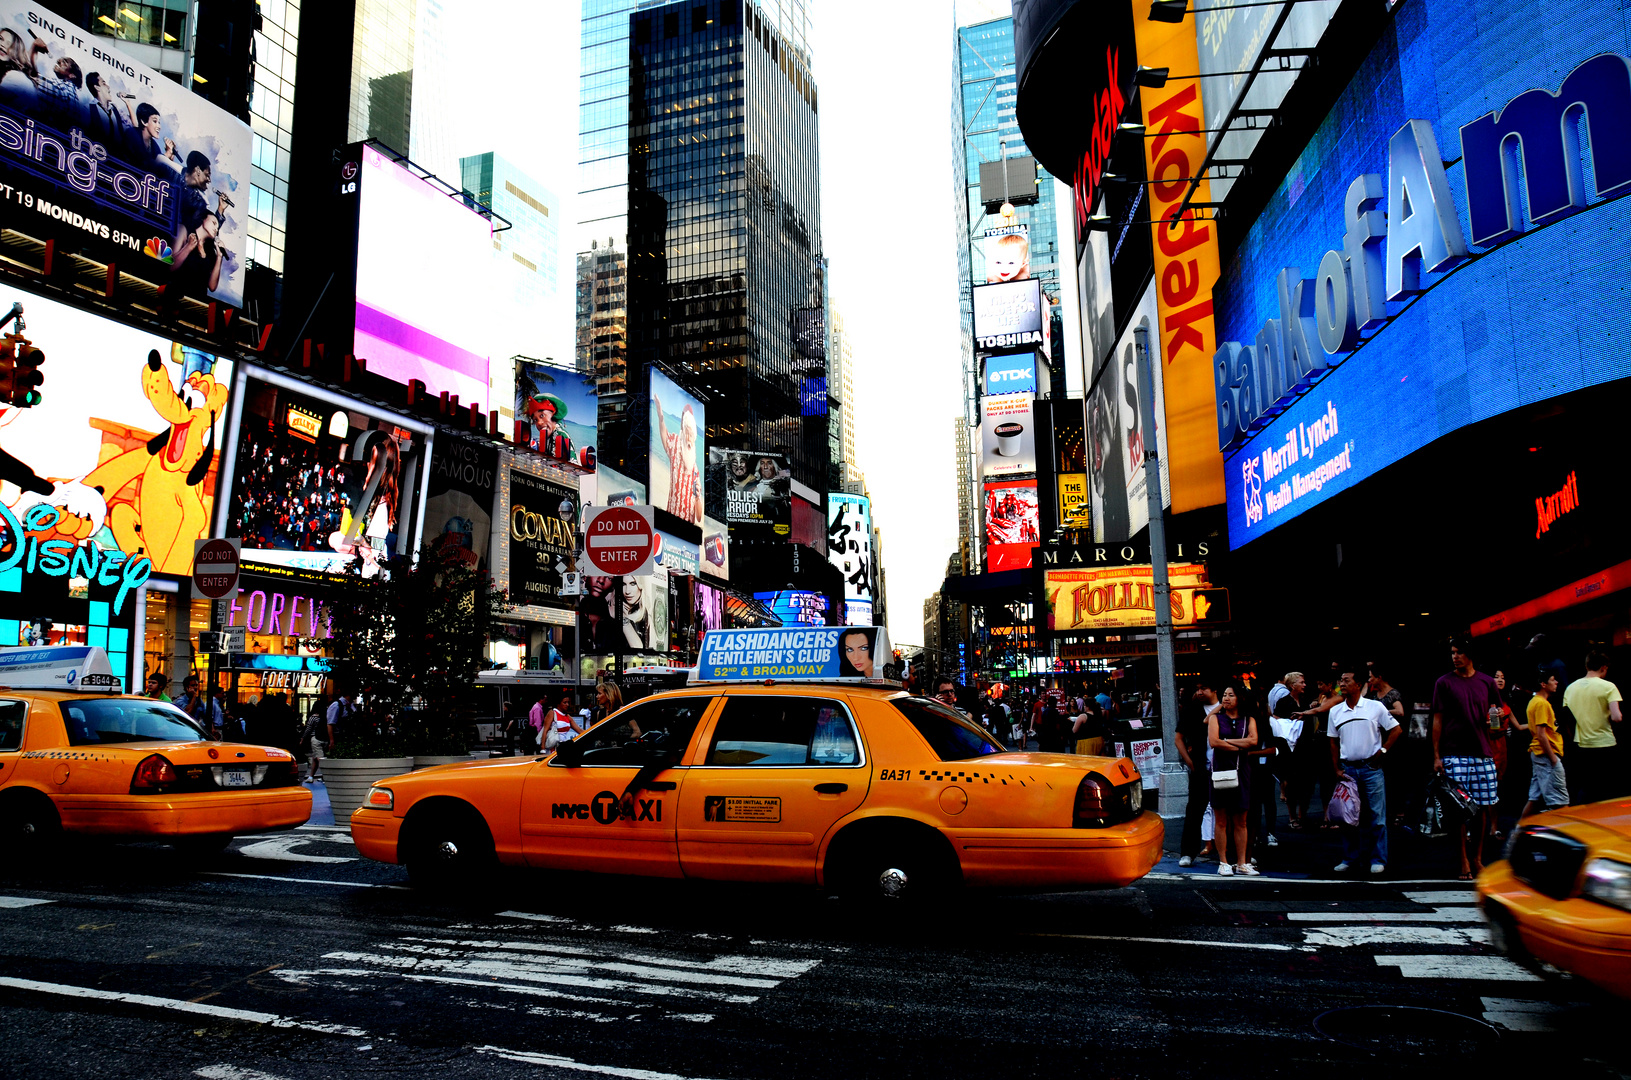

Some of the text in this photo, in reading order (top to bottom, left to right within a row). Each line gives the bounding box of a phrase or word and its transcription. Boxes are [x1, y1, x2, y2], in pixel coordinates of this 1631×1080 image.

[27, 11, 154, 89] SING IT. BRING IT.
[70, 129, 107, 161] the
[0, 115, 169, 214] sing-off
[342, 182, 356, 194] LG
[16, 190, 34, 208] 19
[37, 198, 110, 239] MONDAYS
[112, 229, 141, 252] 8PM
[1148, 83, 1215, 365] Kodak
[986, 225, 1025, 237] TOSHIBA
[977, 331, 1042, 348] TOSHIBA
[1212, 266, 1328, 453] Bank
[999, 367, 1032, 381] TDK
[1262, 400, 1338, 483] Merrill Lynch
[450, 442, 479, 463] NYC's
[431, 453, 491, 489] FAMOUS
[511, 474, 525, 485] BORN
[536, 482, 545, 491] THE
[1065, 484, 1081, 492] THE
[727, 490, 763, 503] ADLIEST
[1063, 494, 1084, 507] LION
[1266, 480, 1292, 515] Wealth
[1536, 470, 1579, 539] Marriott
[727, 501, 758, 514] RRIOR
[511, 504, 575, 551] CONAN
[597, 520, 640, 531] DO NOT
[202, 551, 232, 560] DO NOT
[526, 540, 573, 556] THE BARBARIAN
[1044, 543, 1209, 564] MARQIS
[536, 552, 550, 564] 3D
[600, 551, 637, 562] ENTER
[663, 552, 695, 576] PEPSI TIME
[1049, 572, 1096, 581] BERNADETTE PETERS
[1099, 569, 1130, 578] JAN MAXWELL
[1185, 565, 1203, 574] RAINES
[202, 578, 228, 587] ENTER
[525, 581, 551, 594] AUGUST
[553, 587, 561, 595] 19
[1070, 581, 1184, 628] FOLLIS
[706, 631, 838, 651] FLASHDANCERS
[708, 649, 831, 666] GENTLEMEN'S CLUB
[1062, 647, 1090, 657] LIMITED
[1091, 645, 1136, 656] ENGAGEMENT
[714, 665, 824, 677] 52ND & BROADWAY
[92, 676, 110, 684] 3G44
[261, 671, 328, 689] FOREVER 21
[880, 769, 911, 781] 8A31
[552, 803, 589, 820] NYC
